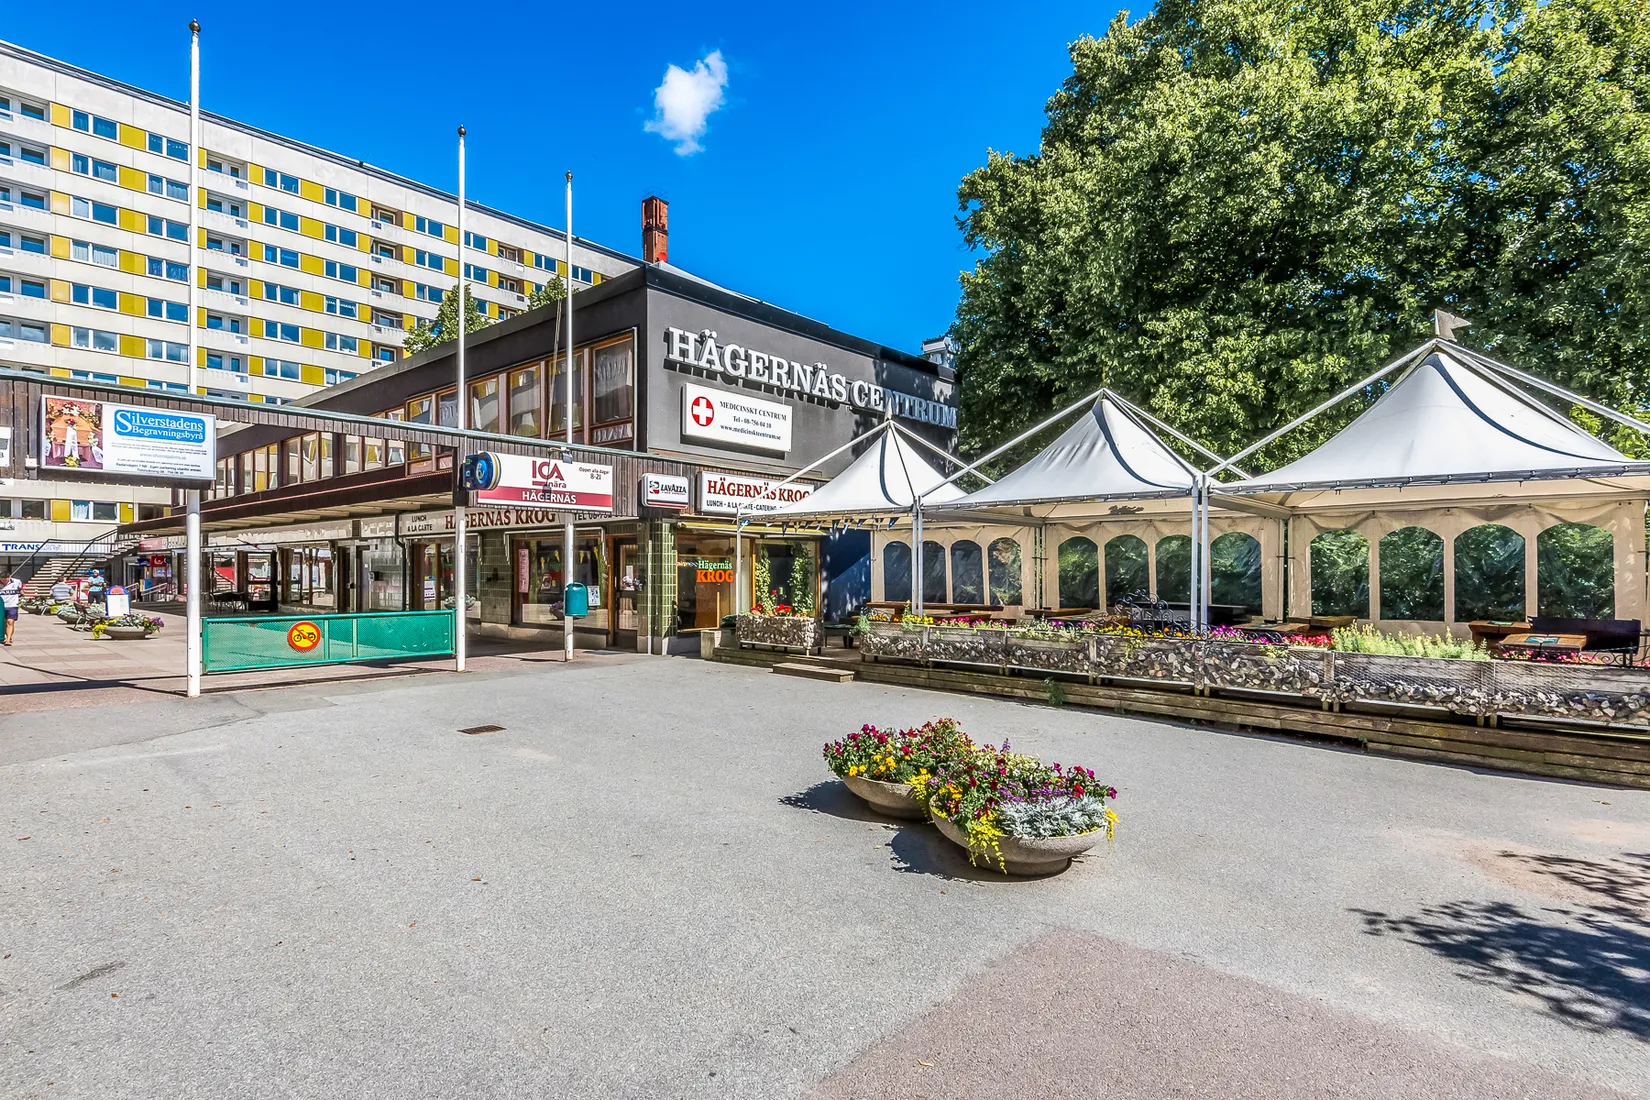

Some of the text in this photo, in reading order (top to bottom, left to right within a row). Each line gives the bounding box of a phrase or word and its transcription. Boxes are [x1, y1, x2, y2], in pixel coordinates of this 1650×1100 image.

[668, 326, 958, 430] HÄGERNÄS CENTRUM
[719, 400, 787, 421] MEDICINSKT CENTRUM
[116, 411, 204, 433] Silverstadens
[733, 415, 741, 423] Tel
[132, 425, 204, 441] Begravningsbyrå
[532, 460, 565, 481] ICA
[549, 479, 567, 489] nära
[660, 483, 687, 494] LAVAZZA
[522, 490, 577, 504] HÄGERNÄS
[706, 499, 723, 507] LUNCH
[411, 515, 427, 523] LUNCH
[698, 560, 733, 571] Hägernäs
[696, 569, 735, 583] KROG
